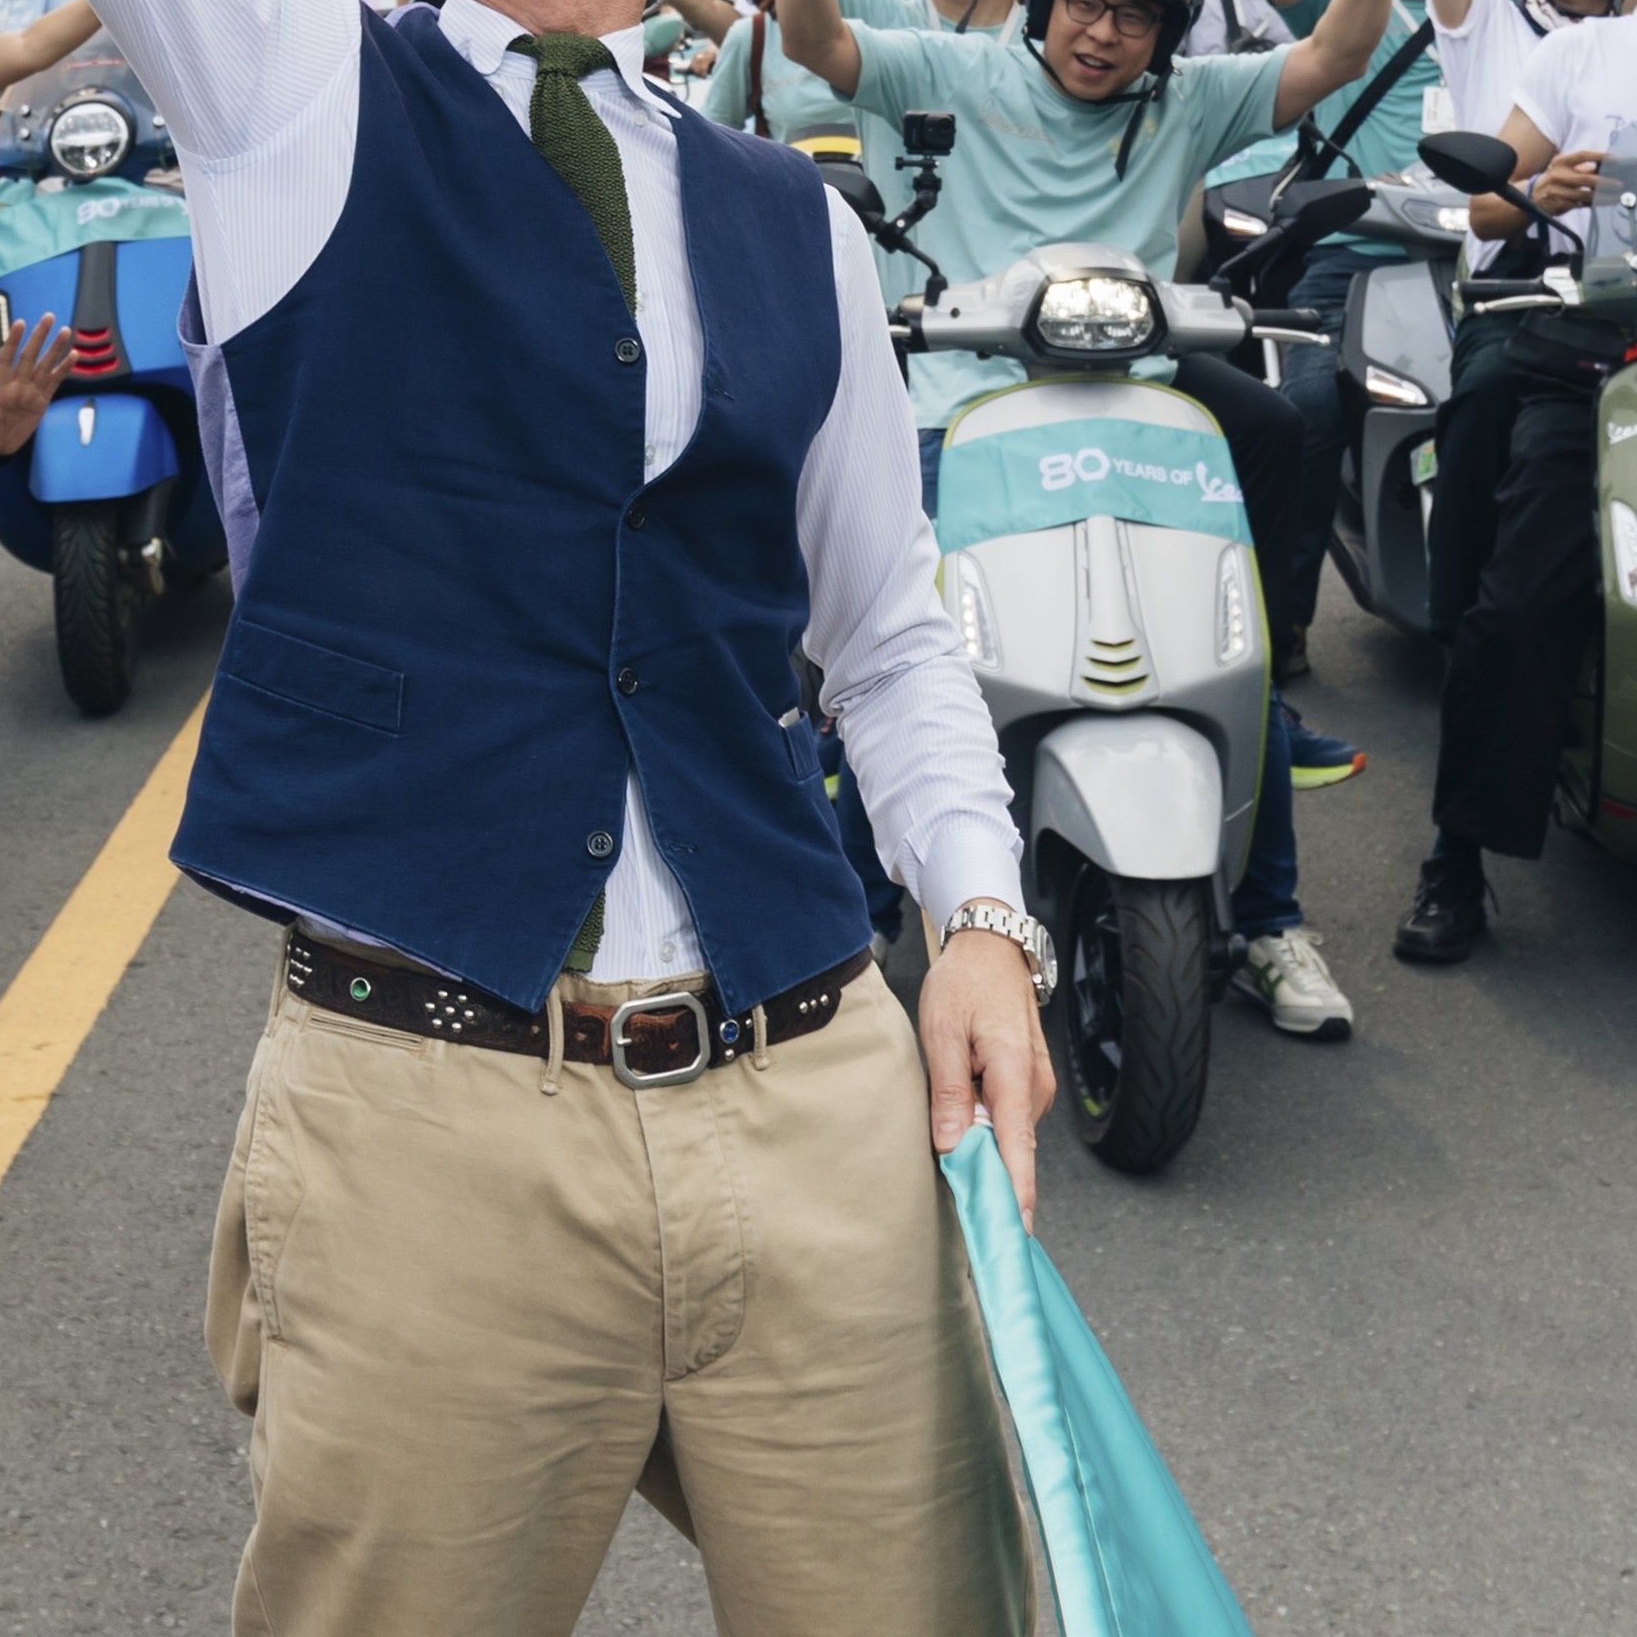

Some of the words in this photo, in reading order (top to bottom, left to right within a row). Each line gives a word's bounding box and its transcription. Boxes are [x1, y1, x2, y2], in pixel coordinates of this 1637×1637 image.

[1038, 447, 1112, 492] 80
[1113, 458, 1167, 483] YEARS
[1170, 468, 1193, 486] OF
